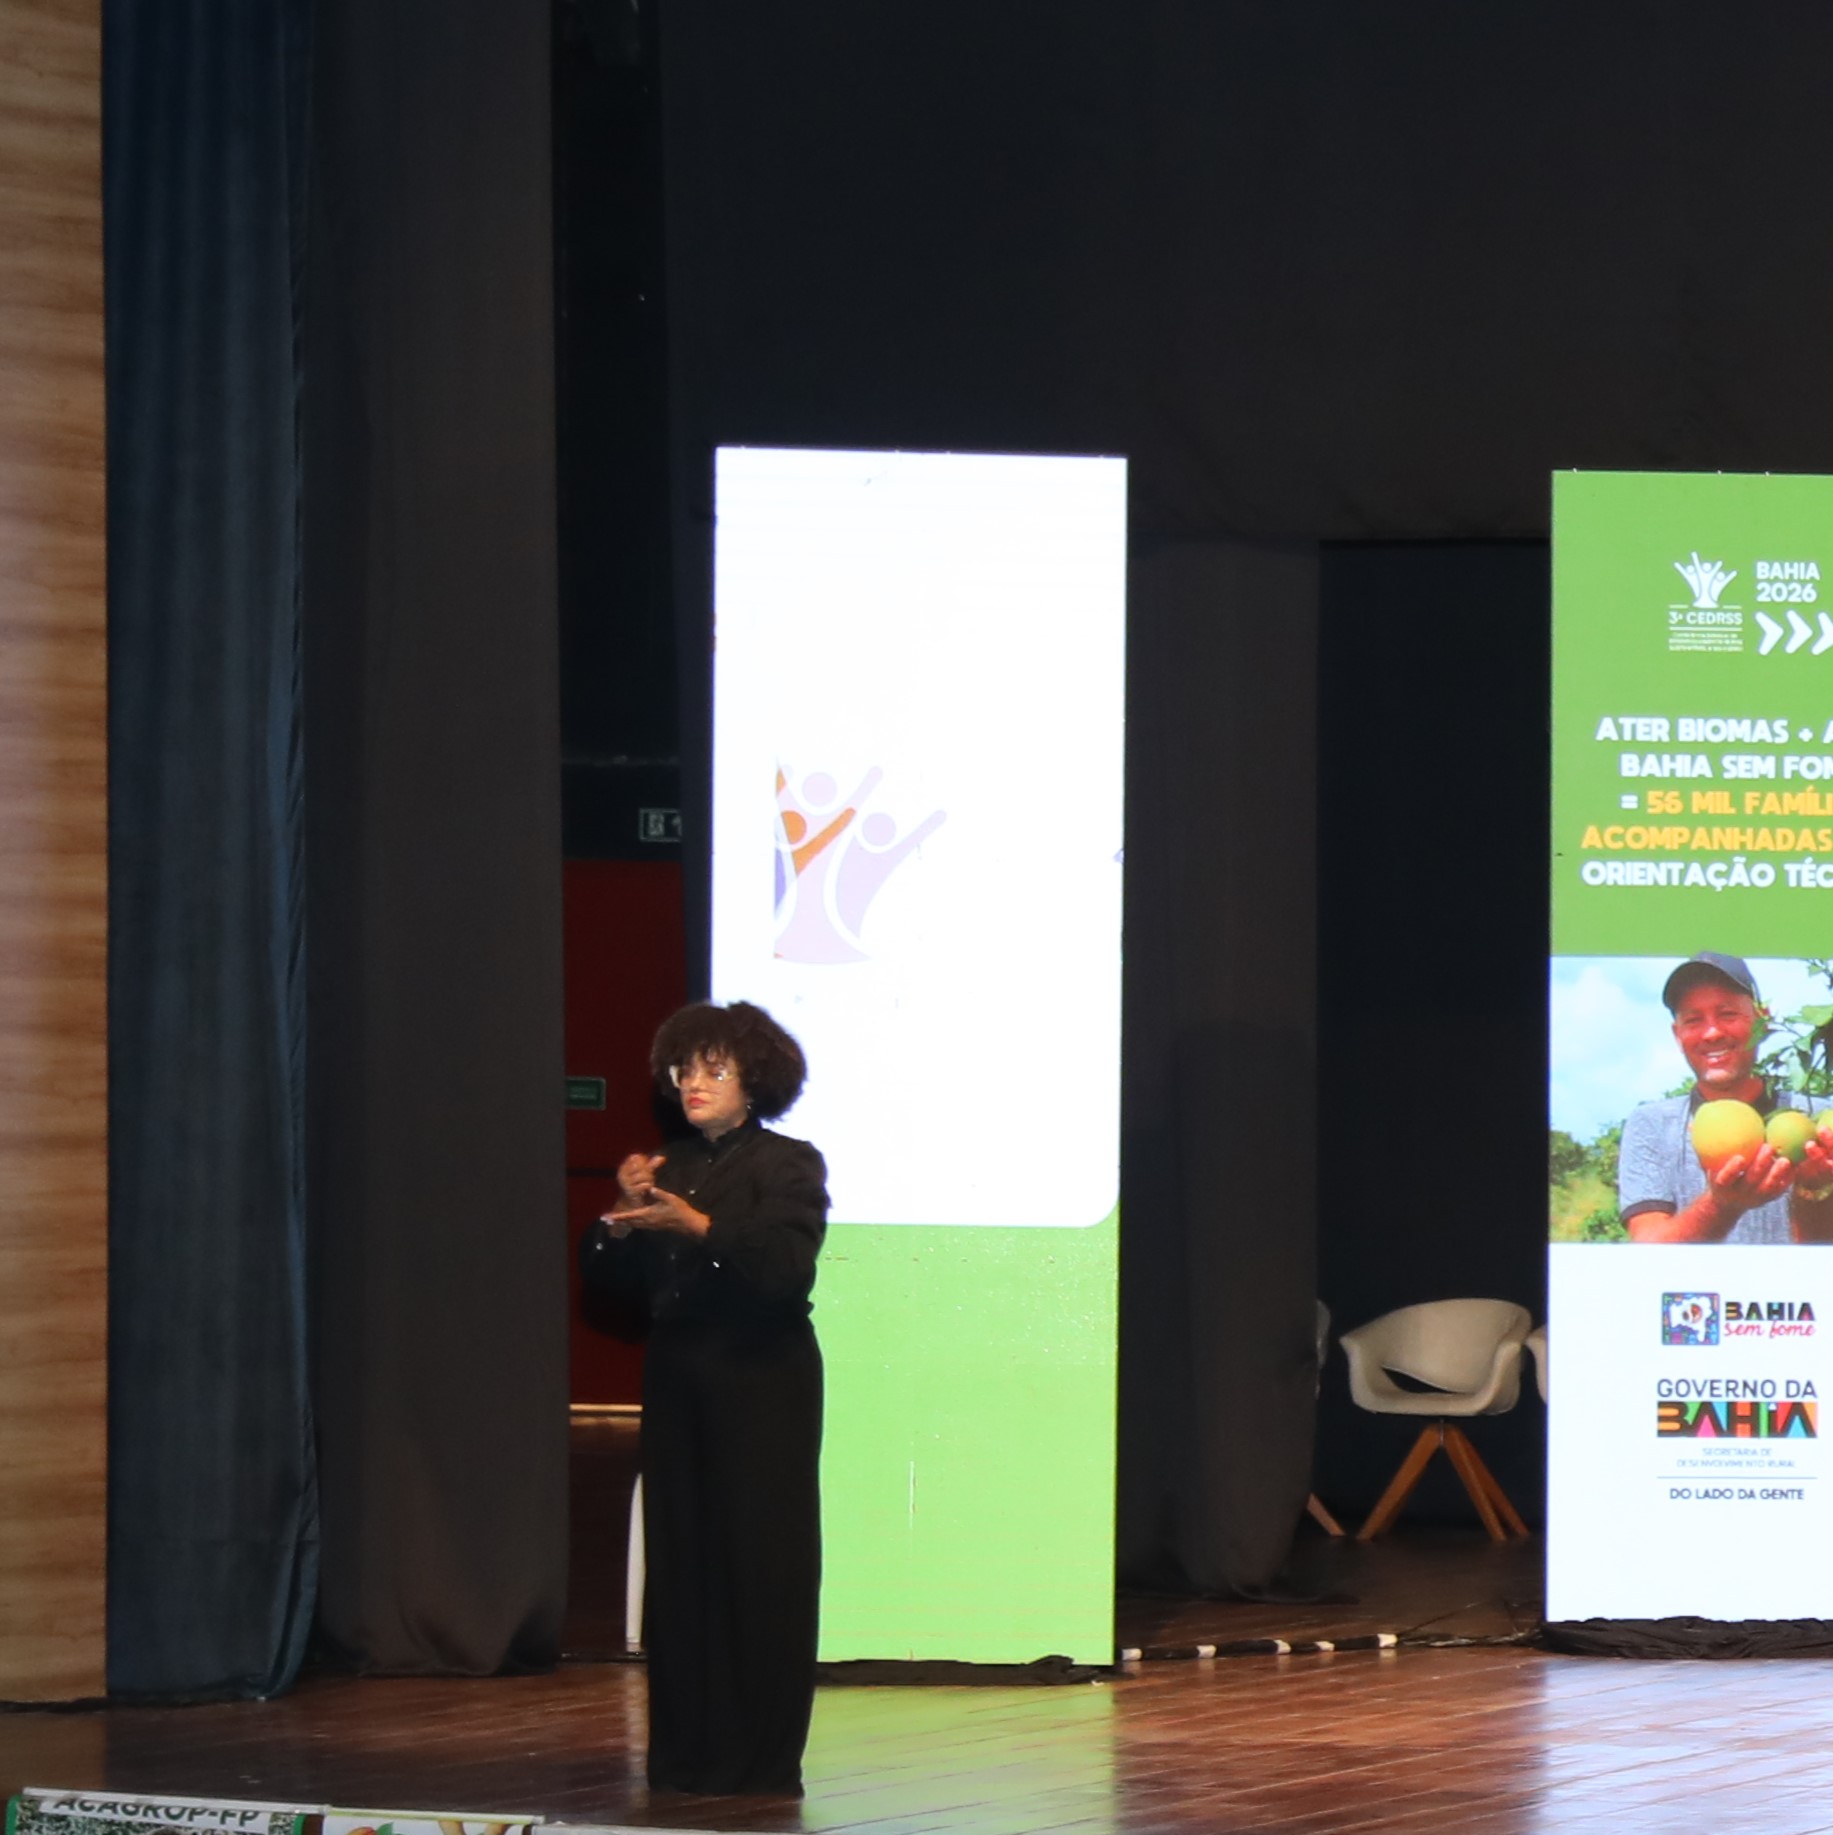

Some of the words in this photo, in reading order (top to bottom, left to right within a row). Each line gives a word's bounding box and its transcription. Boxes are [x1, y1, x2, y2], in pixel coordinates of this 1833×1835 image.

[1756, 561, 1820, 580] BAHIA
[1756, 583, 1817, 602] 2026
[1686, 611, 1743, 625] CEDRSS
[1595, 716, 1670, 742] ATER
[1678, 718, 1789, 743] BIOMAS
[1620, 754, 1713, 778] BAHIA
[1722, 755, 1776, 779] SEM
[1646, 790, 1683, 814] 56
[1691, 791, 1736, 815] MIL
[1580, 825, 1833, 852] ACOMPANHADAS
[1582, 856, 1775, 892] ORIENTAÇÃO
[1725, 1301, 1815, 1321] BAHIA
[1724, 1323, 1764, 1337] sem
[1657, 1379, 1777, 1399] GOVERNO
[1785, 1380, 1817, 1399] DA
[1657, 1401, 1818, 1438] BAHIA
[1670, 1488, 1692, 1500] DO
[1696, 1488, 1733, 1500] LADO
[1738, 1488, 1756, 1500] DA
[1760, 1488, 1804, 1500] GENTE
